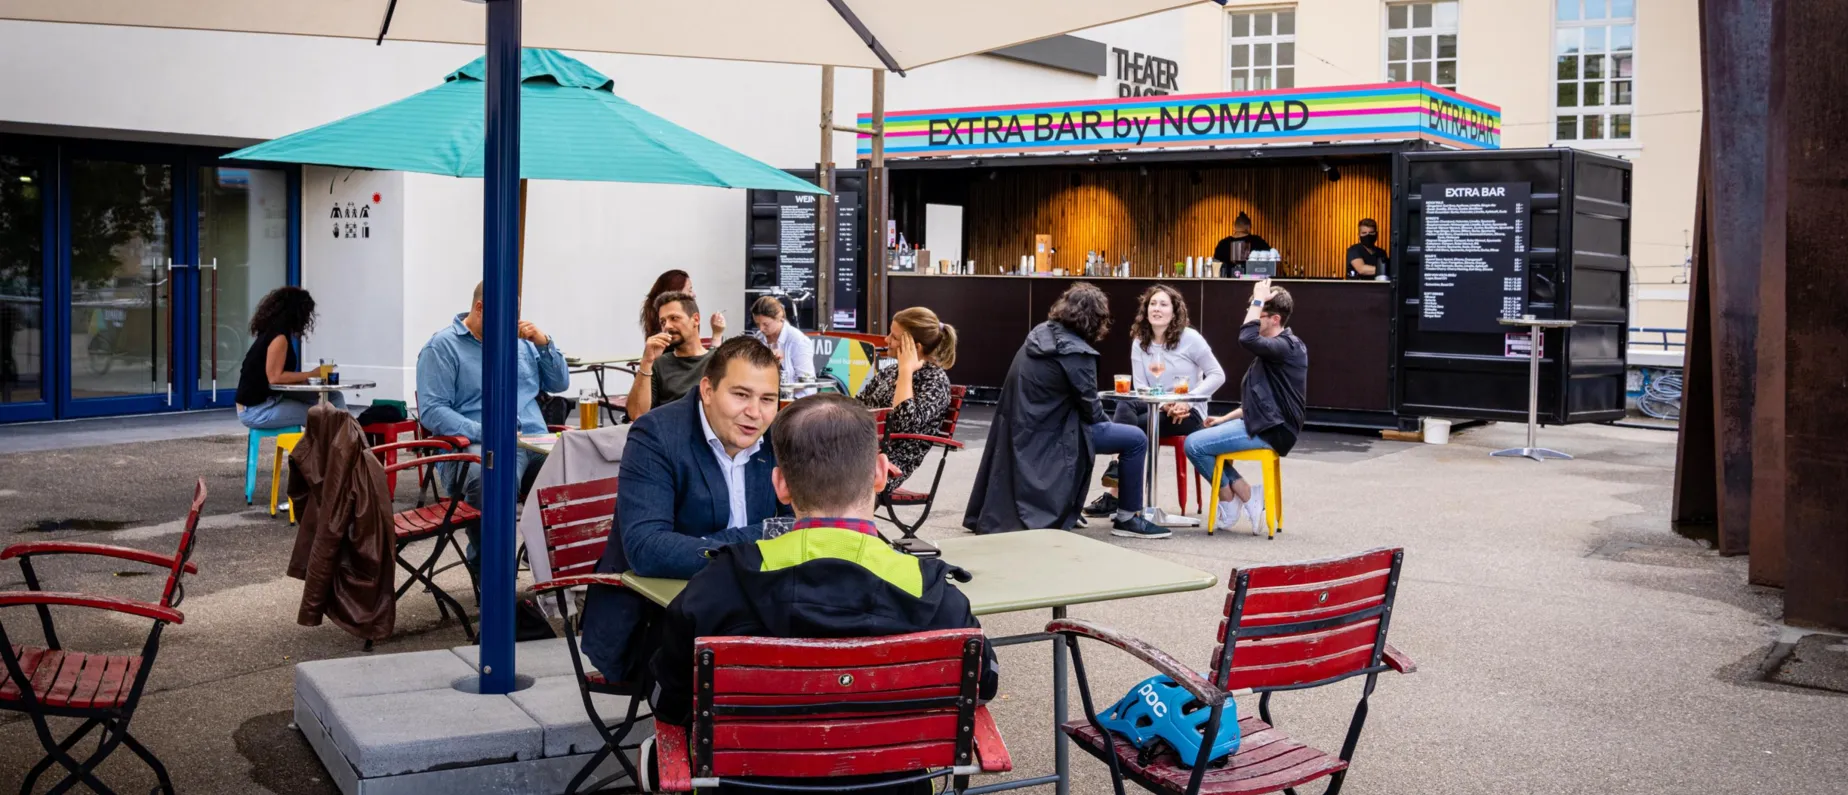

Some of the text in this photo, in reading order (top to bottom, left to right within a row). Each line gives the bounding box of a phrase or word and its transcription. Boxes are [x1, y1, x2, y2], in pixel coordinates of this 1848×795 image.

[1112, 47, 1179, 91] THEATER
[929, 100, 1309, 146] EXTRA BAR by NOMAD
[1429, 96, 1494, 145] EXTRA BAR
[1445, 187, 1505, 197] EXTRA BAR
